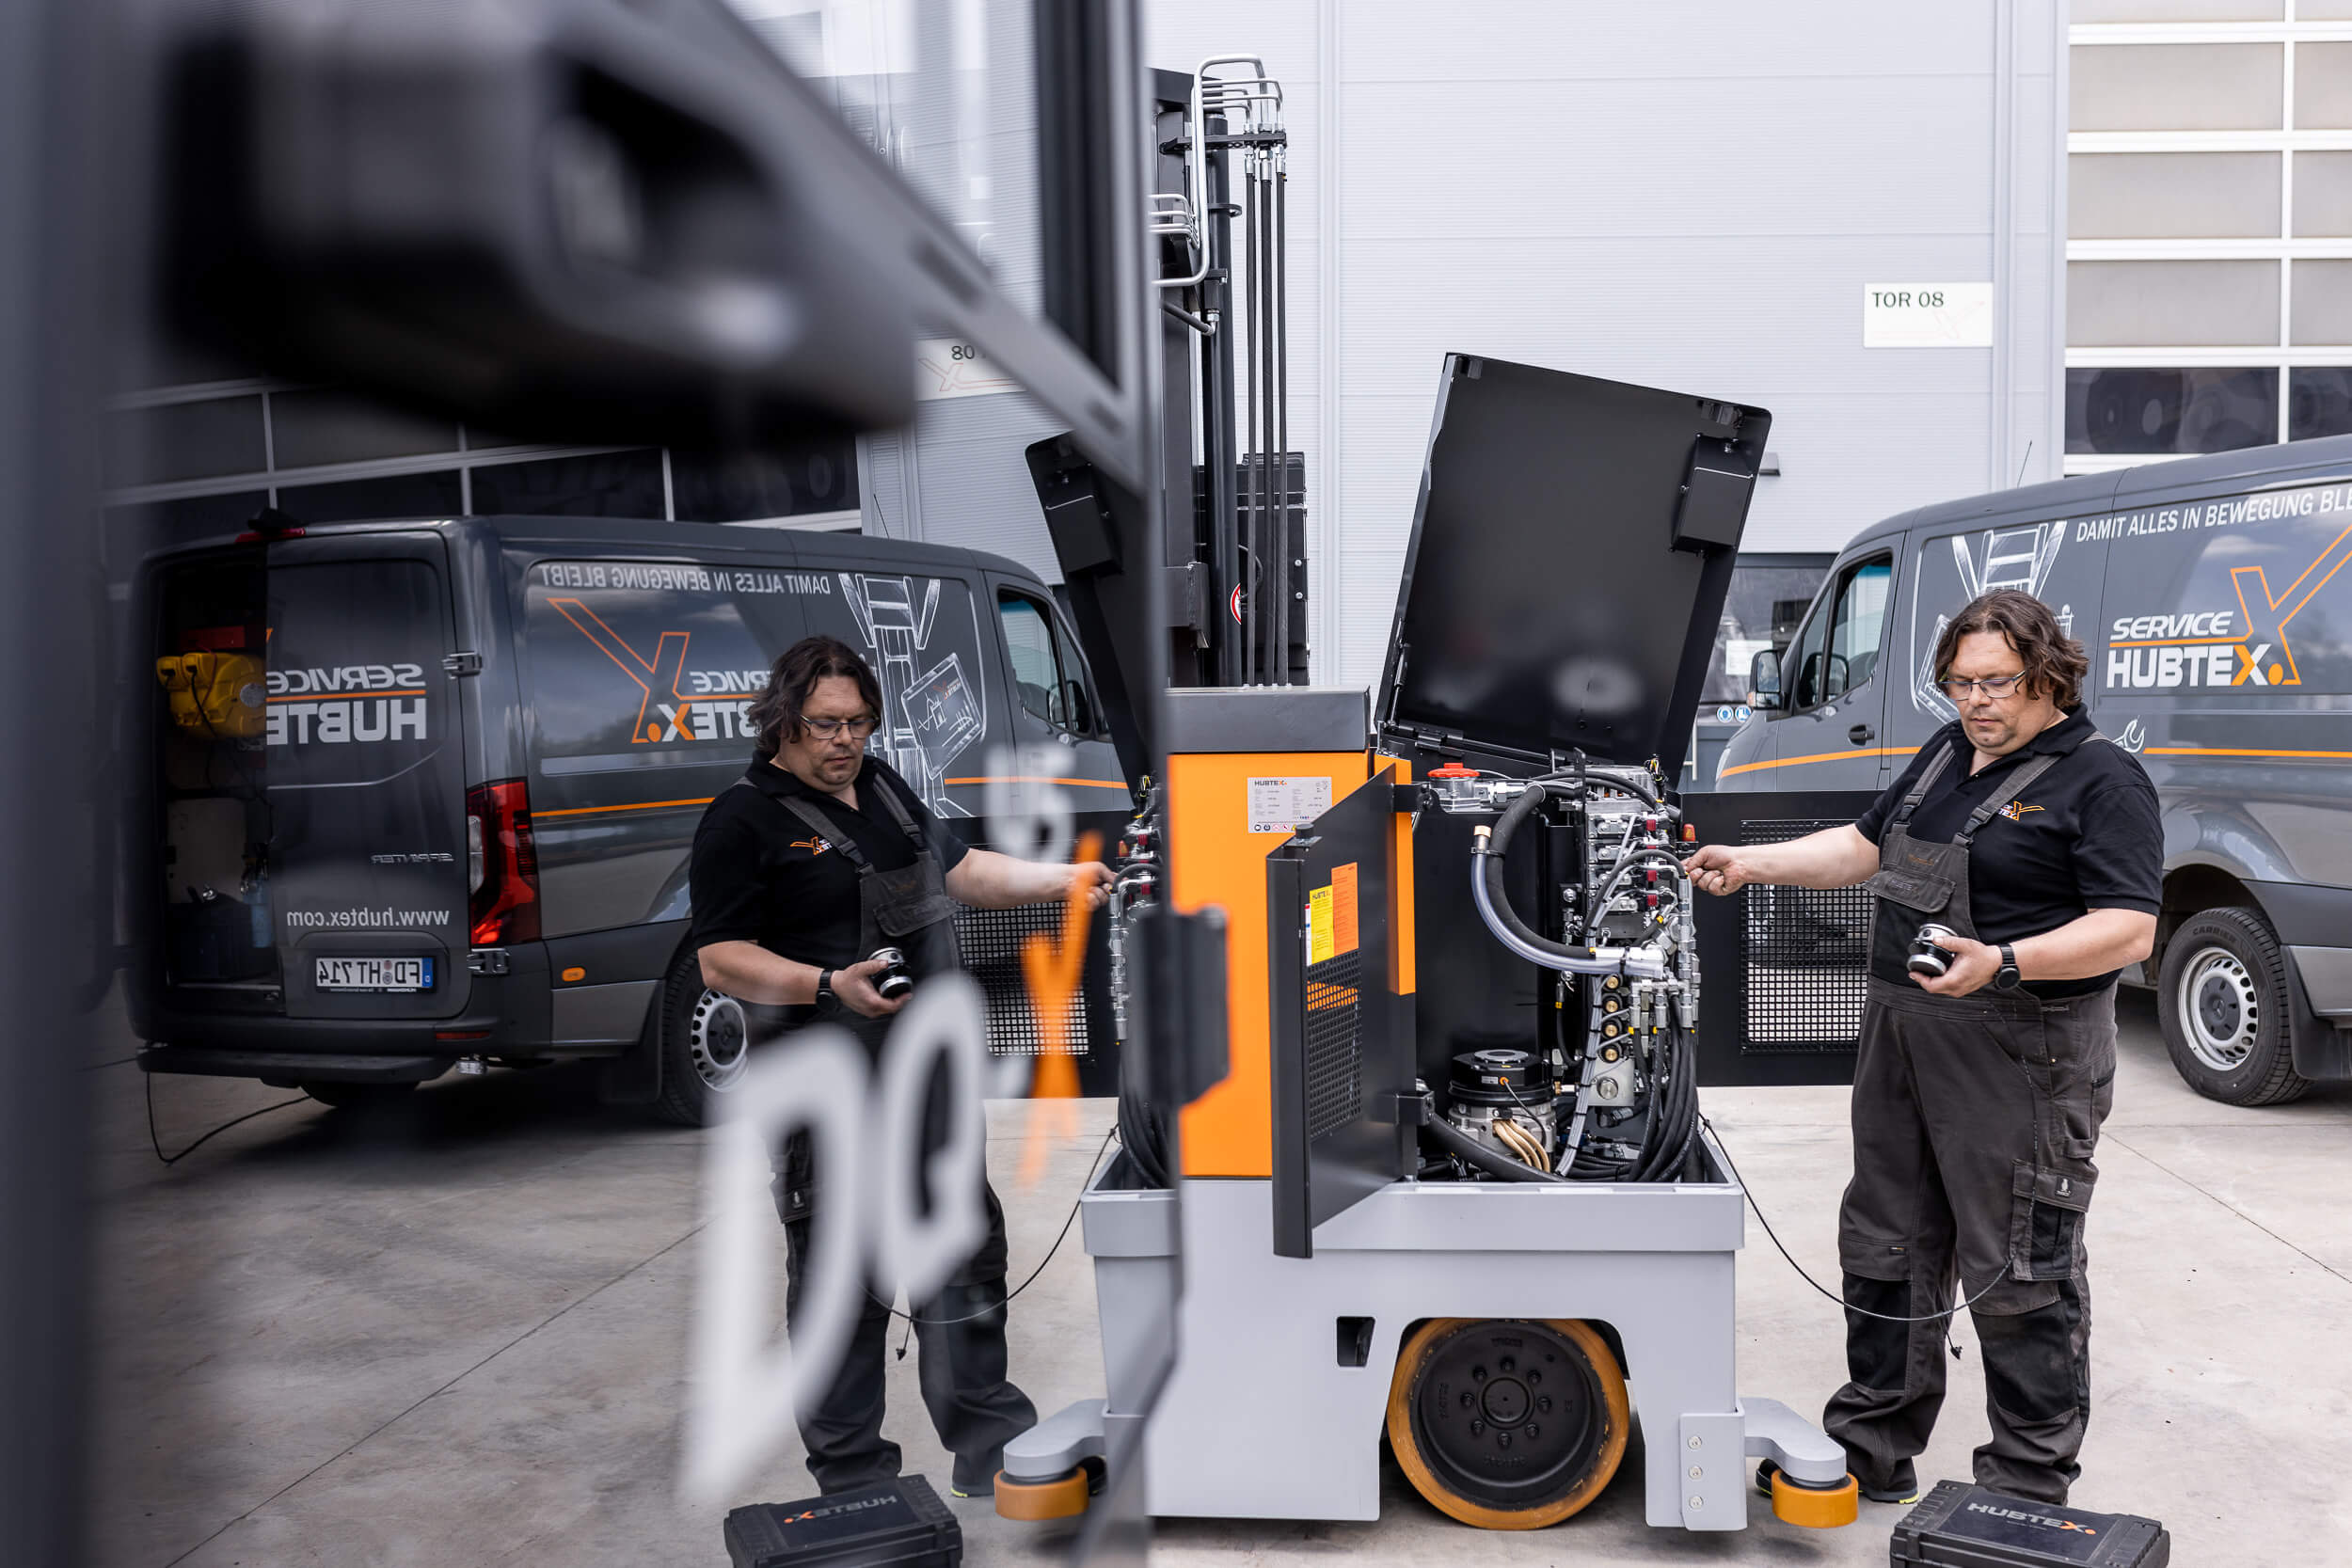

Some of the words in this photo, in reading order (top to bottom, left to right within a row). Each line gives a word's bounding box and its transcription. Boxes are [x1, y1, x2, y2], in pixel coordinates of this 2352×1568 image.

[1871, 292, 1912, 309] TOR
[1918, 291, 1945, 309] 08
[2075, 516, 2126, 543] DAMIT
[2126, 509, 2180, 537] ALLES
[2182, 506, 2202, 530] IN
[2205, 492, 2313, 528] BEWEGUNG
[2110, 610, 2234, 641] SERVICE
